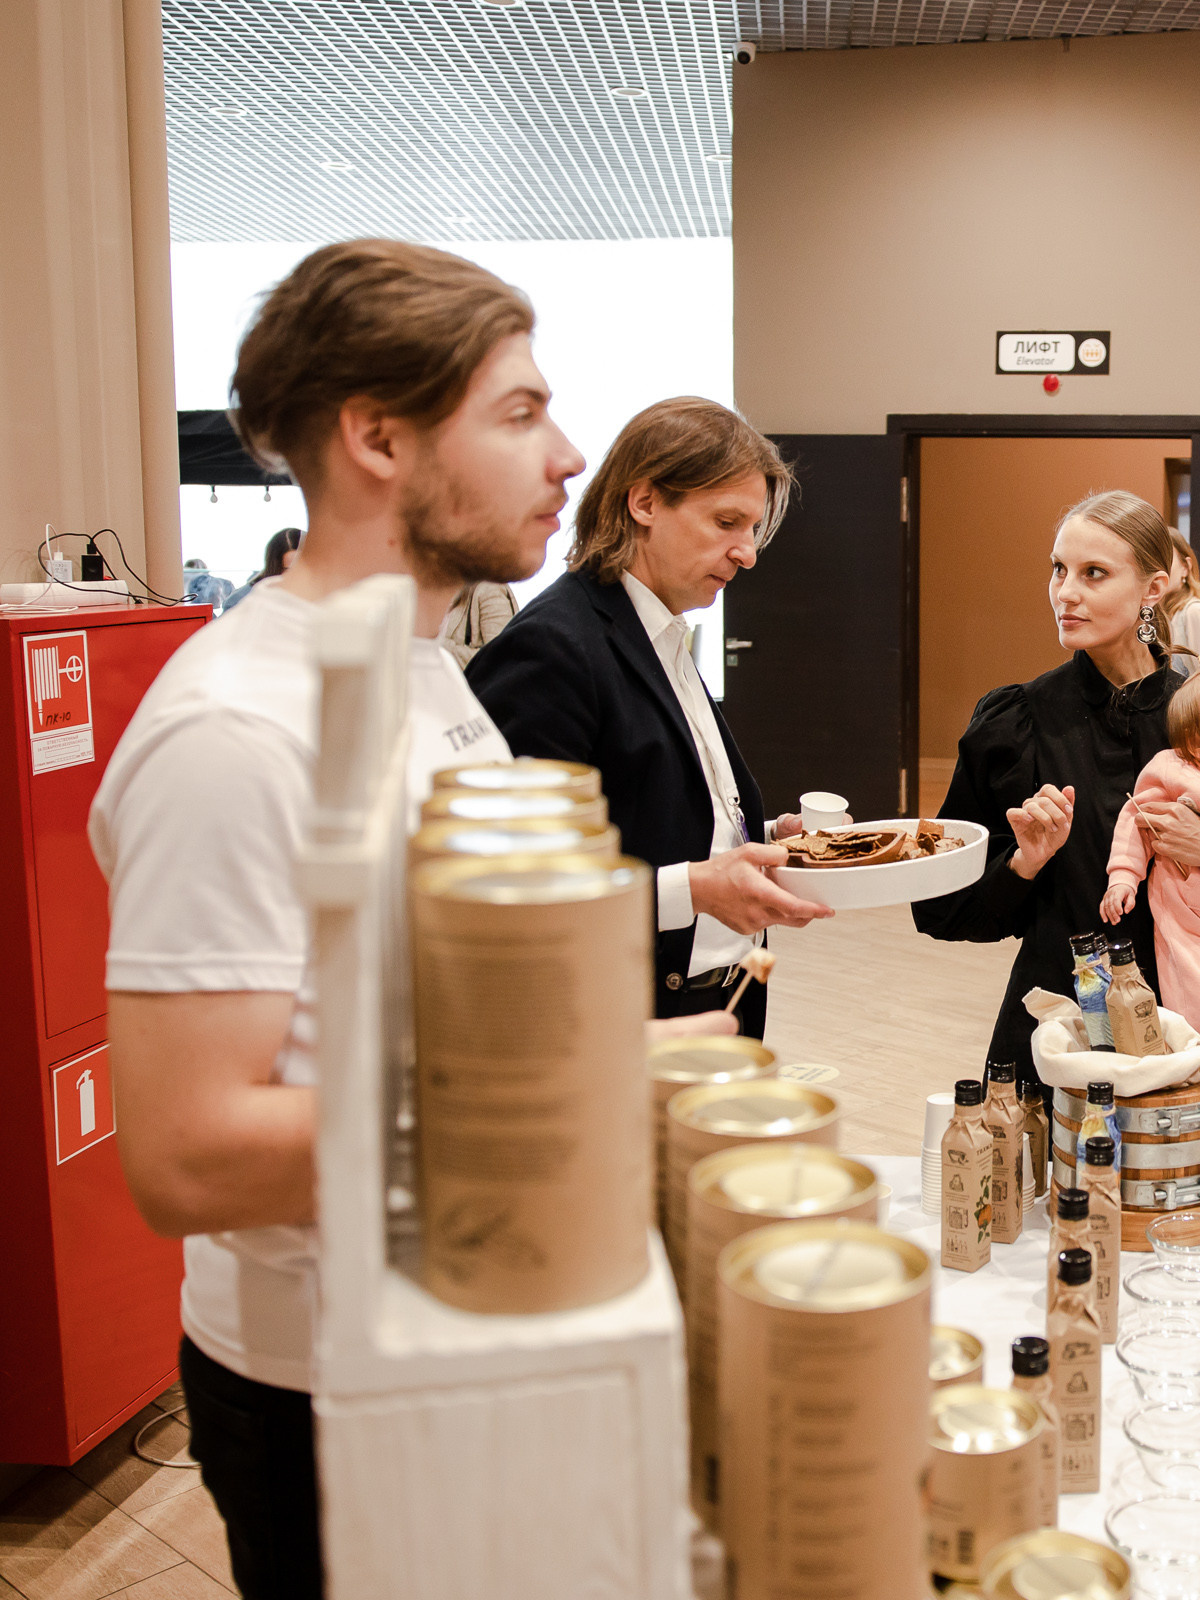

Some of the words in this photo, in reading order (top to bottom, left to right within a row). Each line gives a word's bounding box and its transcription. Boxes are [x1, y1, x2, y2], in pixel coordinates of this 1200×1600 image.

[1014, 341, 1061, 353] ЛИФТ
[1016, 356, 1055, 366] Elevator
[46, 711, 71, 726] ПК-10
